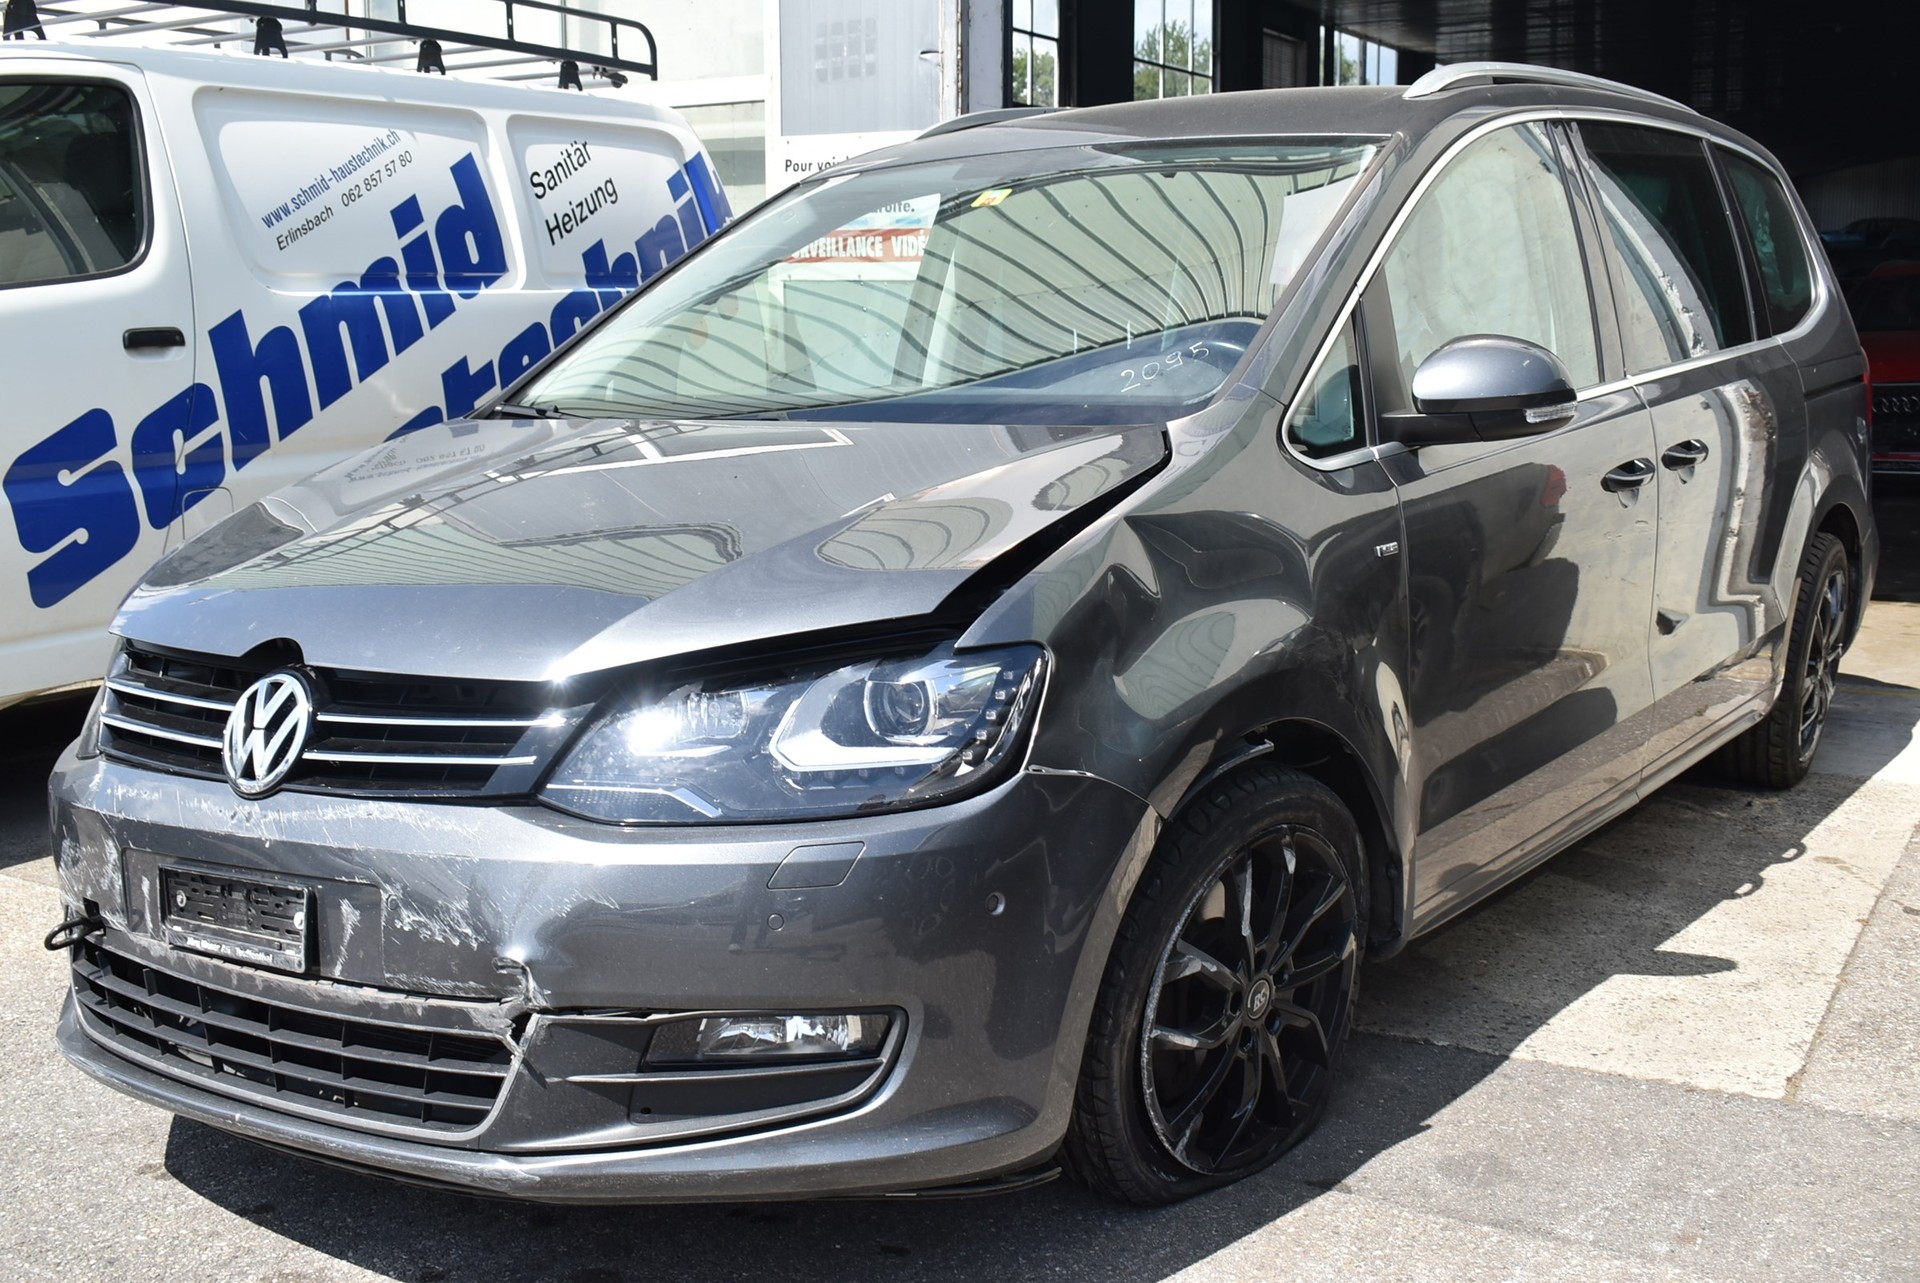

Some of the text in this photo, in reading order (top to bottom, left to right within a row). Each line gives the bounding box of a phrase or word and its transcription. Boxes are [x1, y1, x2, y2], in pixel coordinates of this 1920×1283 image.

[261, 128, 401, 229] www.schmid-haustechnik.ch
[529, 140, 592, 200] Sanitär
[785, 159, 813, 172] Pour
[817, 156, 842, 171] voi
[276, 150, 413, 251] Erlinsbach 062 857 57 80
[545, 177, 618, 246] Heizung
[890, 229, 929, 257] VIDÉ
[2, 151, 510, 609] Schmid
[1120, 341, 1209, 393] 2095
[223, 673, 311, 796] VW
